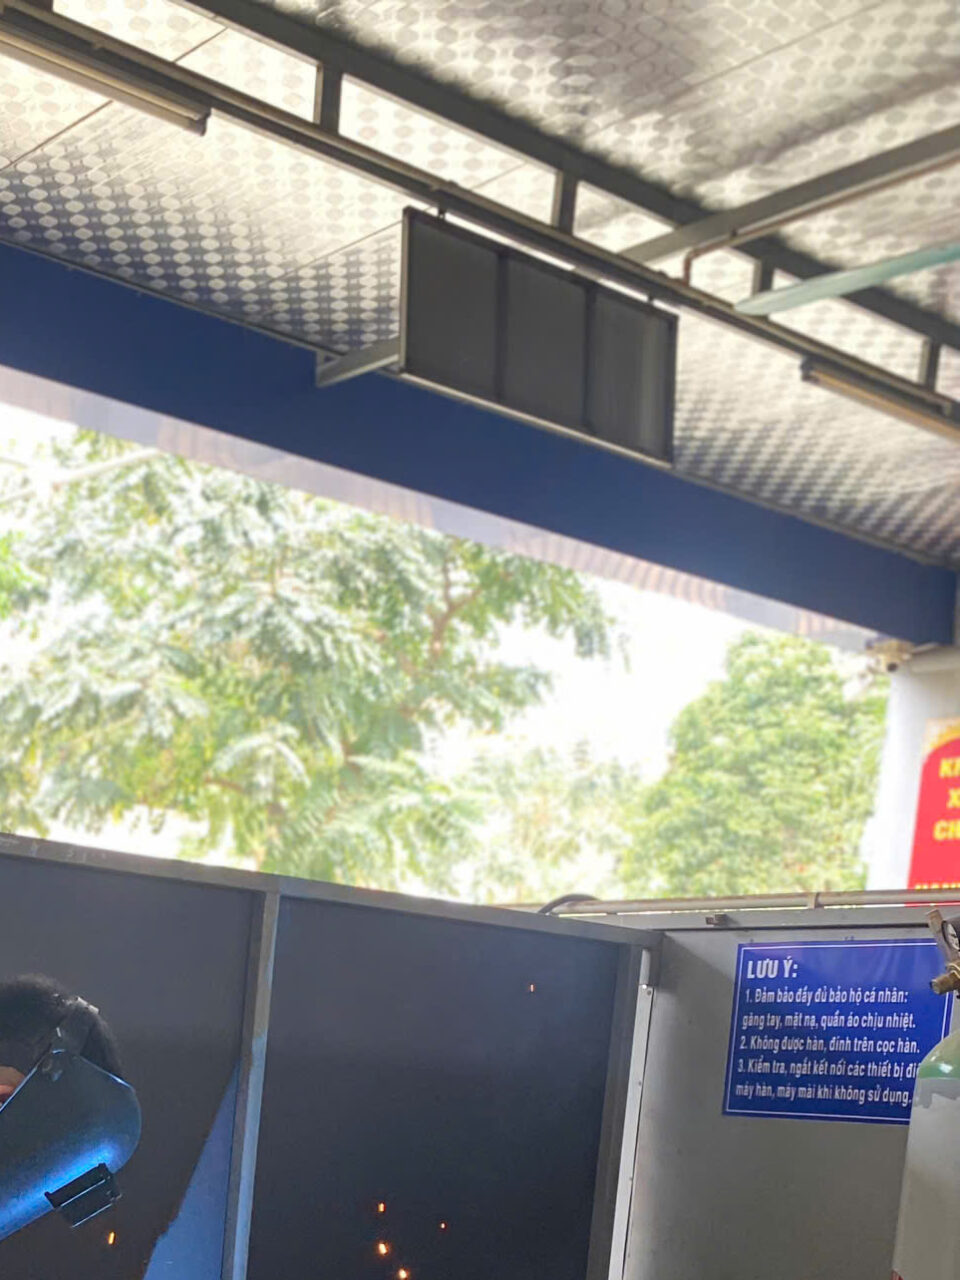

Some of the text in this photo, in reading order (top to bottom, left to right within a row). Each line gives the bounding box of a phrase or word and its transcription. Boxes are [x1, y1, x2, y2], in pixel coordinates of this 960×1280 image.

[747, 956, 798, 979] LƯU Ý:
[745, 988, 753, 1003] 1.
[755, 986, 775, 1003] Đảm
[776, 986, 794, 1003] bảo
[814, 986, 827, 1003] đủ
[829, 985, 847, 1003] bảo
[848, 987, 861, 1006] hộ
[863, 987, 876, 1003] cá
[877, 987, 908, 1003] nhân:
[766, 1013, 782, 1029] tay,
[803, 1014, 818, 1029] nạ,
[847, 1012, 859, 1027] áo
[861, 1012, 883, 1031] chịu
[885, 1012, 916, 1031] nhiệt.
[740, 1035, 920, 1056] 2. Không được hàn, đính trên cọc hàn.
[737, 1059, 745, 1072] 3.
[747, 1055, 770, 1073] Kiểm
[772, 1060, 787, 1076] tra,
[789, 1057, 811, 1078] ngắt
[812, 1058, 828, 1075] kết
[829, 1058, 846, 1075] nối
[847, 1060, 865, 1076] các
[867, 1060, 891, 1077] thiết
[893, 1062, 904, 1081] bị
[736, 1081, 912, 1107] máy hàn, máy mài khi không sử dụng.
